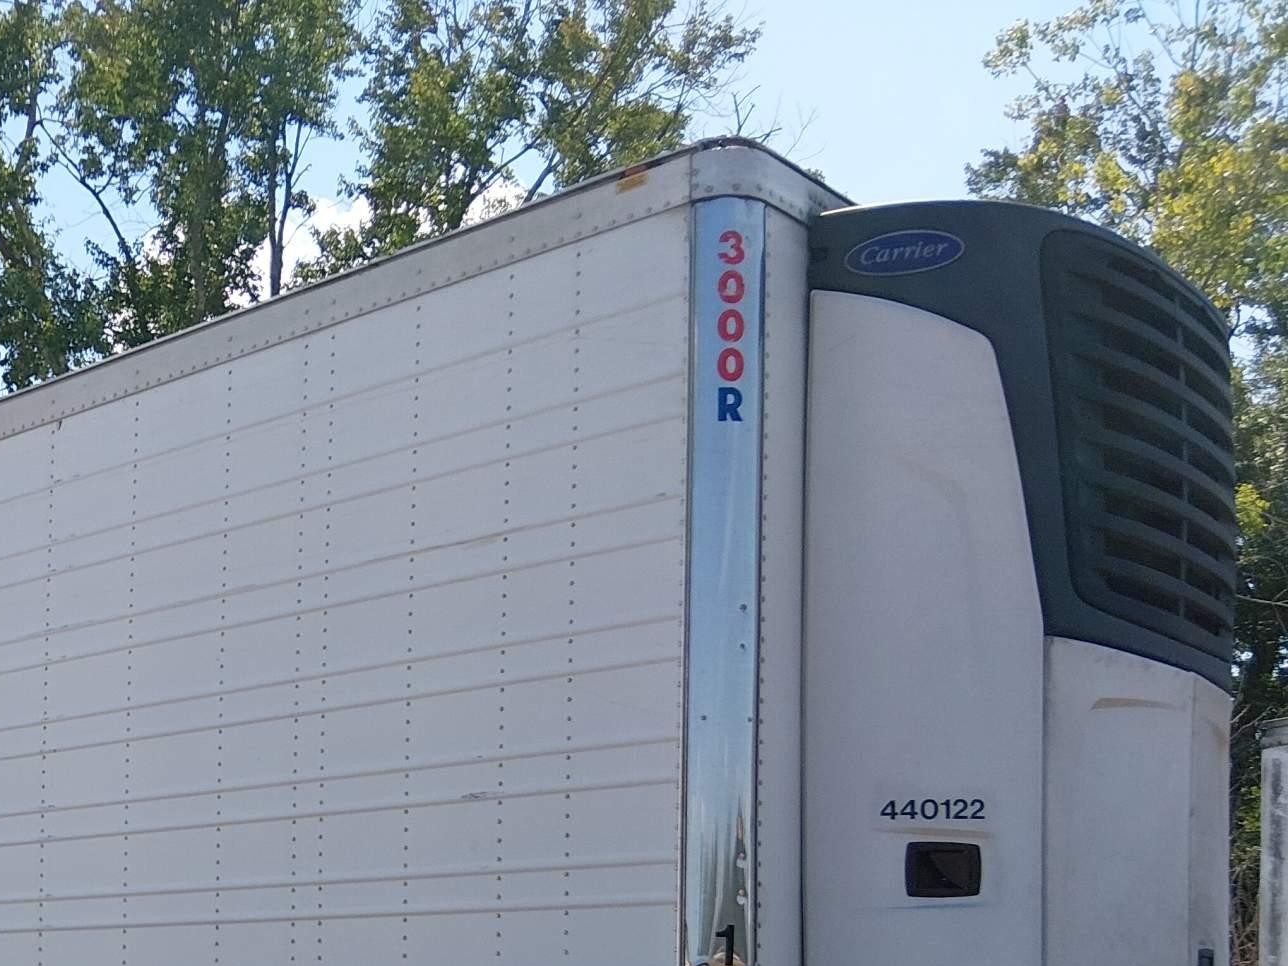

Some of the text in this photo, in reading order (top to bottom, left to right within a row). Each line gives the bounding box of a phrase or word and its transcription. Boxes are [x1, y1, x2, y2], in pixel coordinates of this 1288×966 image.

[860, 242, 949, 265] Carrier
[717, 230, 745, 422] 3000R
[880, 799, 985, 820] 440122
